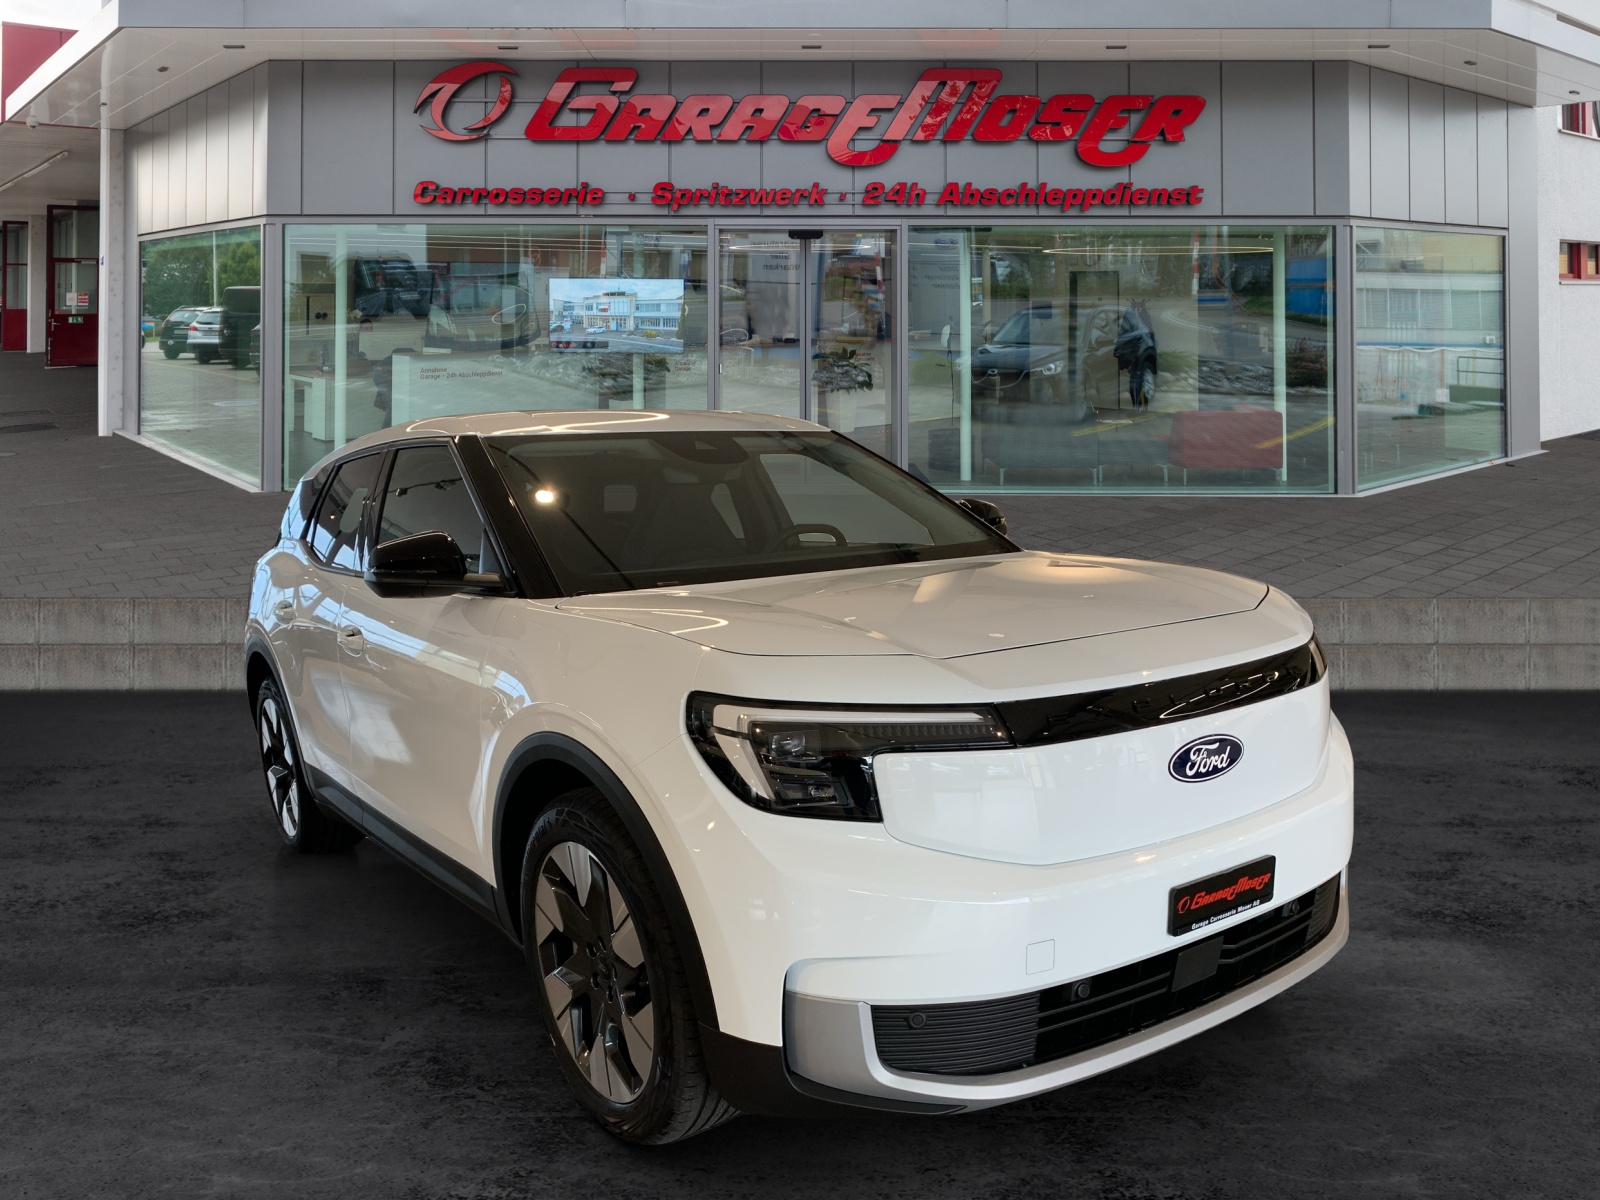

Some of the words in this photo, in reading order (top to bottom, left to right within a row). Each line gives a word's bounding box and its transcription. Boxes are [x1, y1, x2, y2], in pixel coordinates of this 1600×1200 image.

[413, 181, 604, 206] Carrosserie
[651, 181, 827, 211] Spritzwerk
[862, 182, 927, 206] 24h
[937, 182, 1204, 212] Abschleppdienst
[458, 370, 503, 379] Abschleppdienst
[1185, 742, 1230, 776] Ford
[1191, 919, 1209, 930] Garage
[1252, 899, 1260, 907] AG
